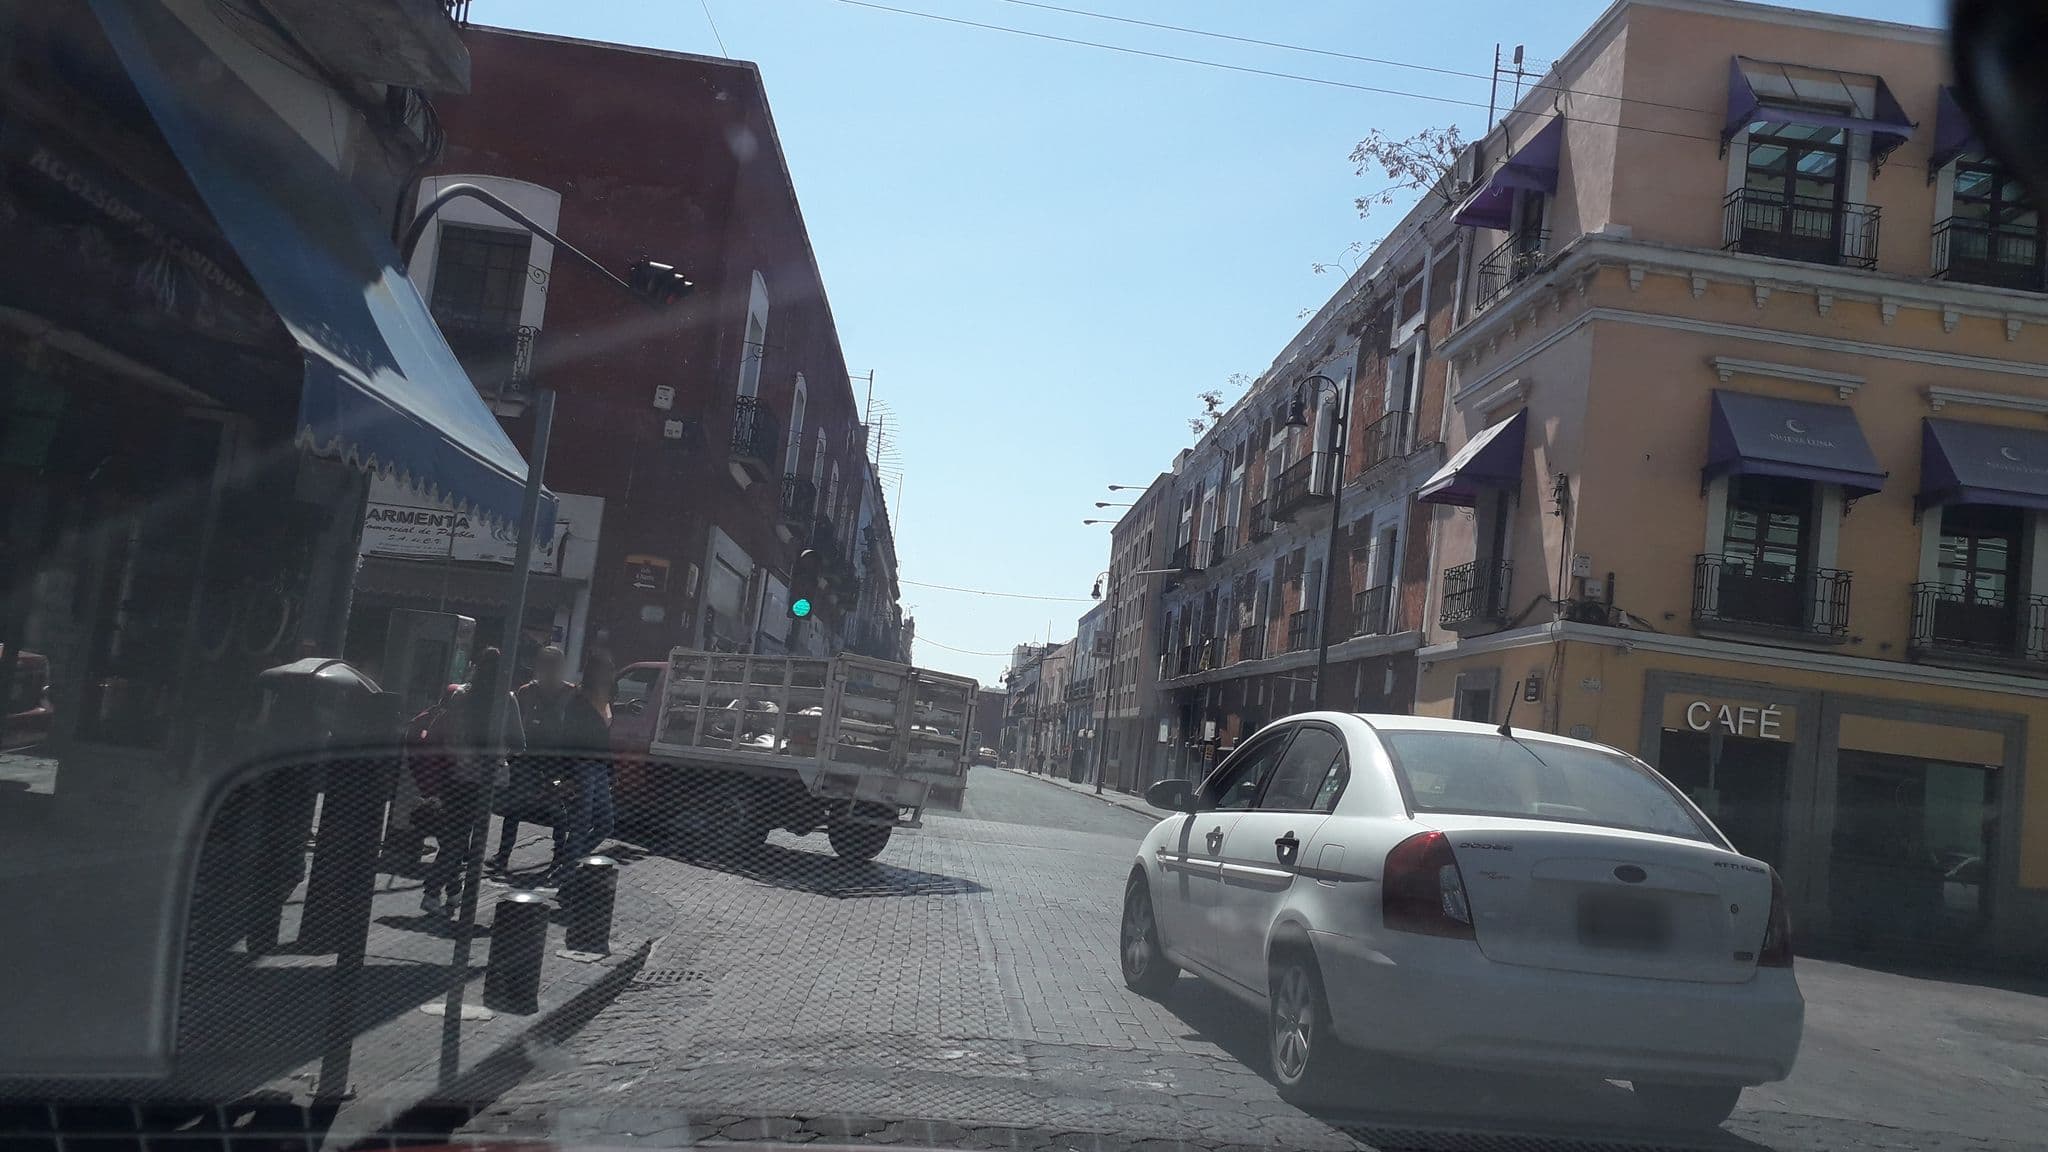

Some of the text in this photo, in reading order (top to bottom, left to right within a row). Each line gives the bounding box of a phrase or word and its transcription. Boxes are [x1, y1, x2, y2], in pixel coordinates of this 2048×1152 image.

[366, 508, 470, 529] ARMENTA
[1687, 701, 1782, 739] CAFÉ
[1459, 842, 1512, 852] DODGE
